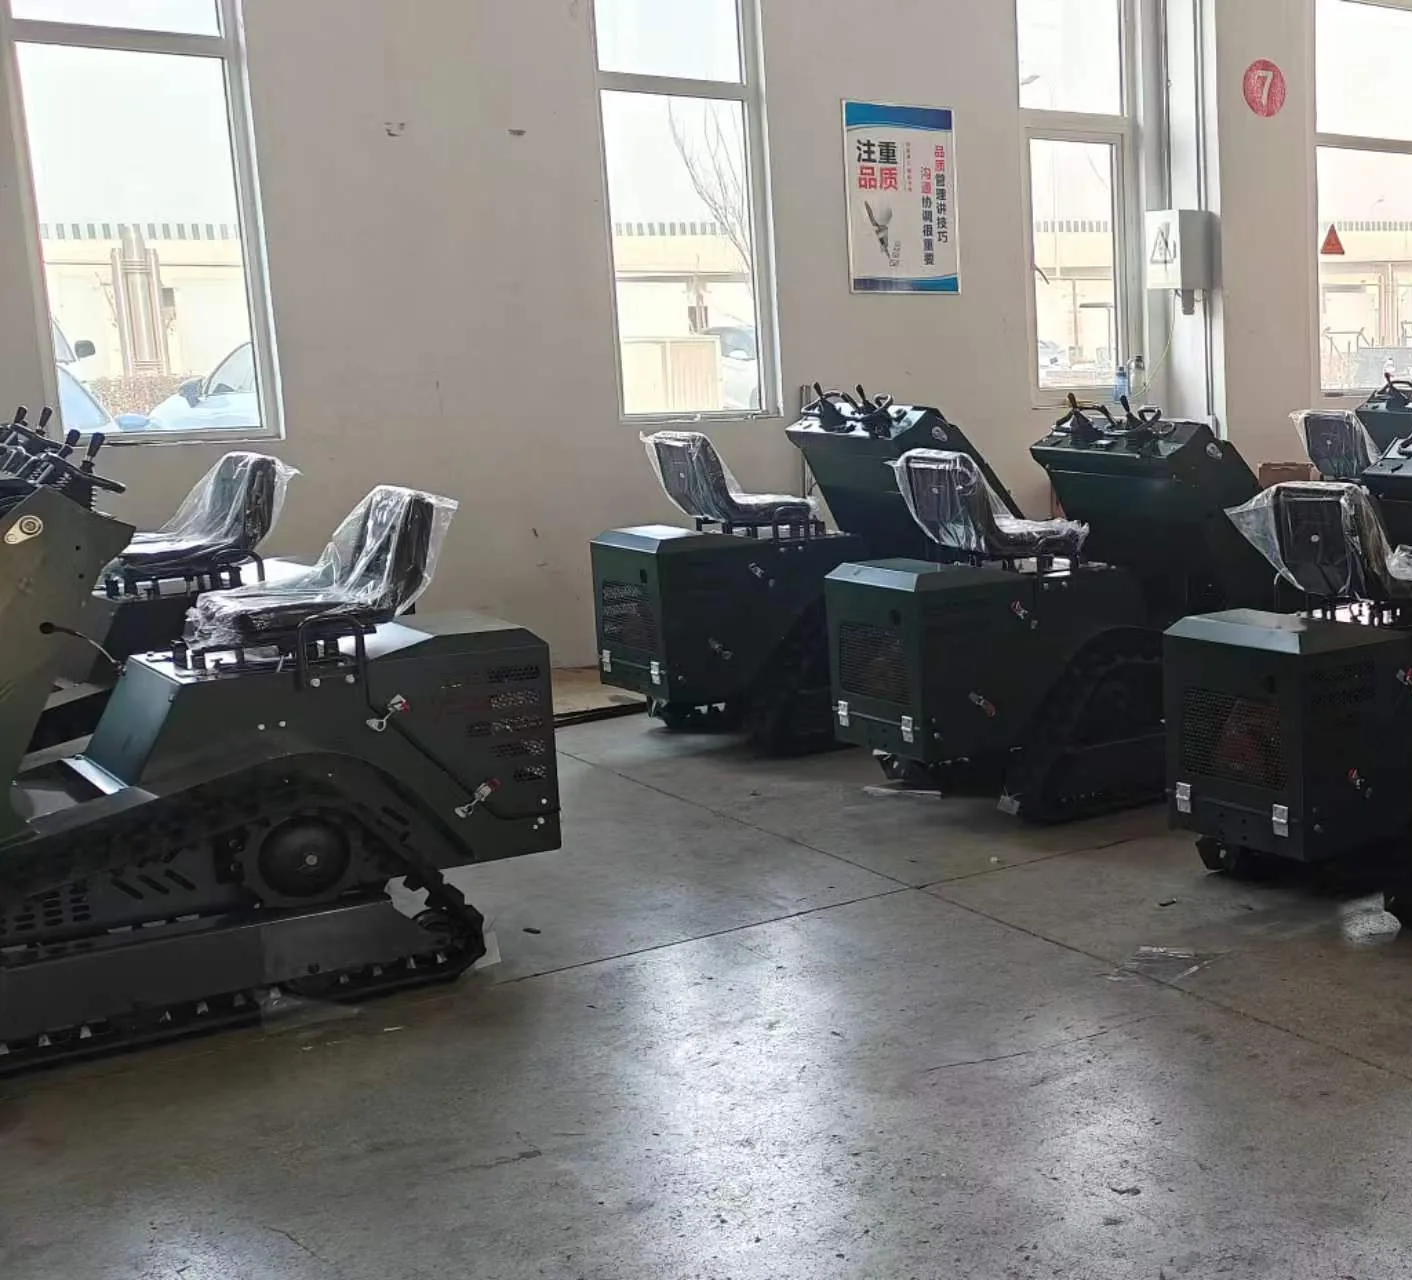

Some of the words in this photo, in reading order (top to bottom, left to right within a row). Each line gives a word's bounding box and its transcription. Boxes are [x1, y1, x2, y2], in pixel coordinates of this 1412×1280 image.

[1256, 70, 1274, 107] 7
[856, 139, 898, 165] 注重
[858, 166, 899, 191] 品质
[934, 145, 948, 243] 品质管理讲技巧
[920, 166, 935, 265] 沟通协调很重要
